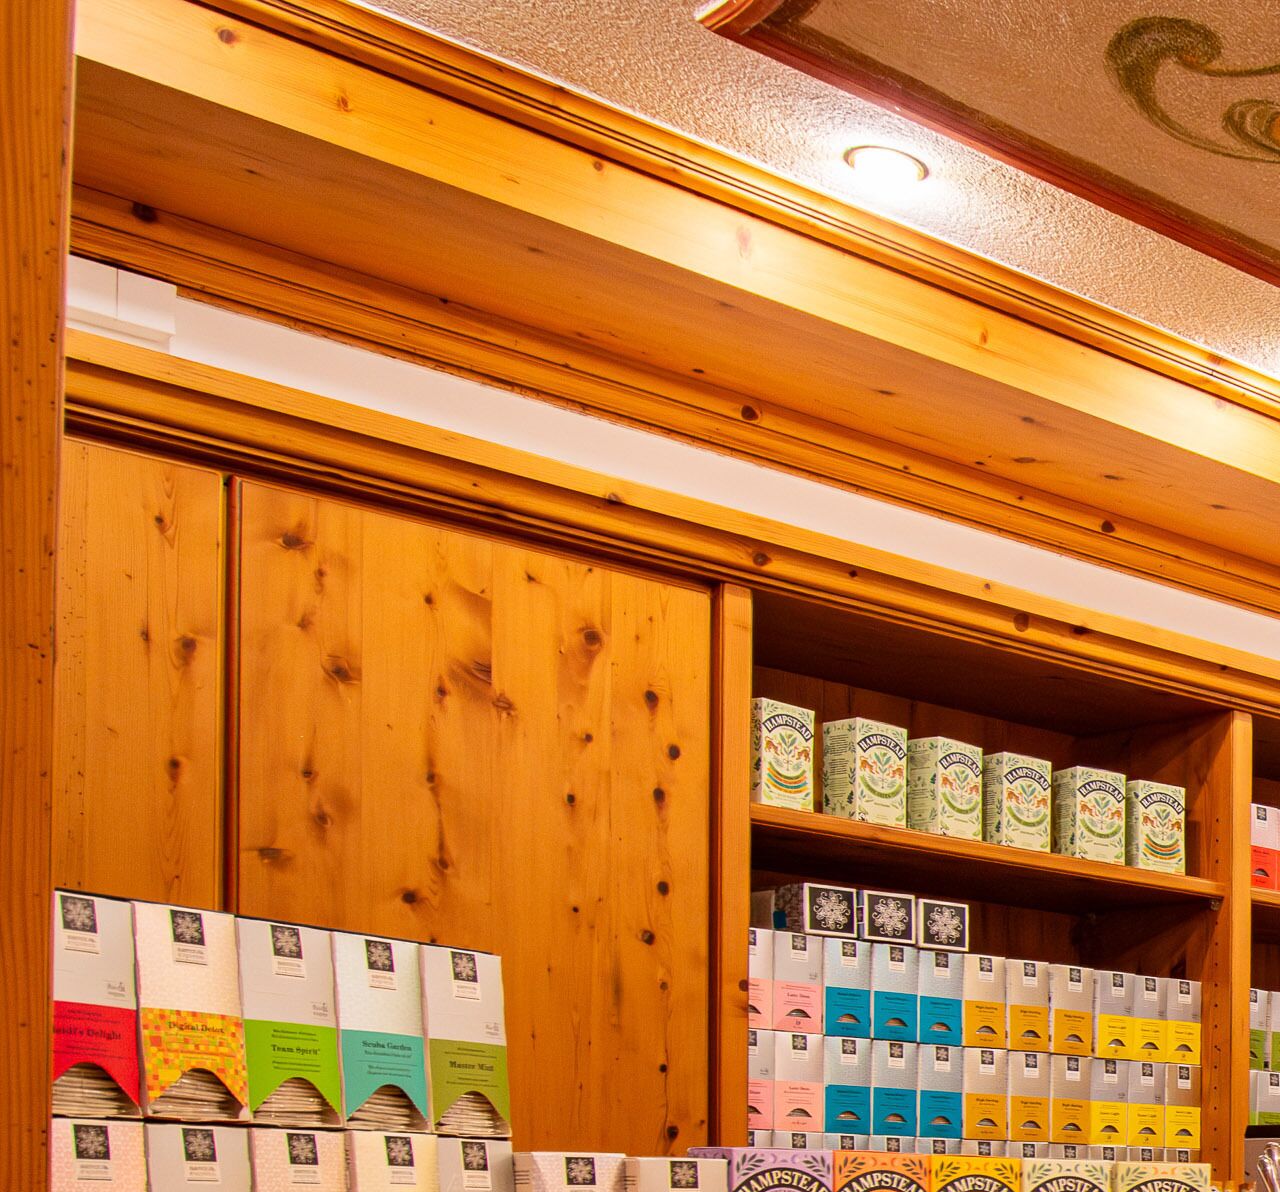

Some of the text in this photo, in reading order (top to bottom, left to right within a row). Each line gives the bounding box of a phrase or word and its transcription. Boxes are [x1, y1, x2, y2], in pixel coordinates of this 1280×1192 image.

[764, 715, 812, 741] HAMPSTEAD
[859, 735, 905, 760] HAMPSTEAD
[941, 753, 981, 777] HAMPSTEAD
[1006, 768, 1049, 791] HAMPSTEAD
[1079, 781, 1124, 803] HAMPSTEAD
[1142, 793, 1184, 814] HAMPSTEAD
[168, 1021, 199, 1032] Digital
[271, 1044, 294, 1053] Team
[362, 1040, 386, 1049] Scuba
